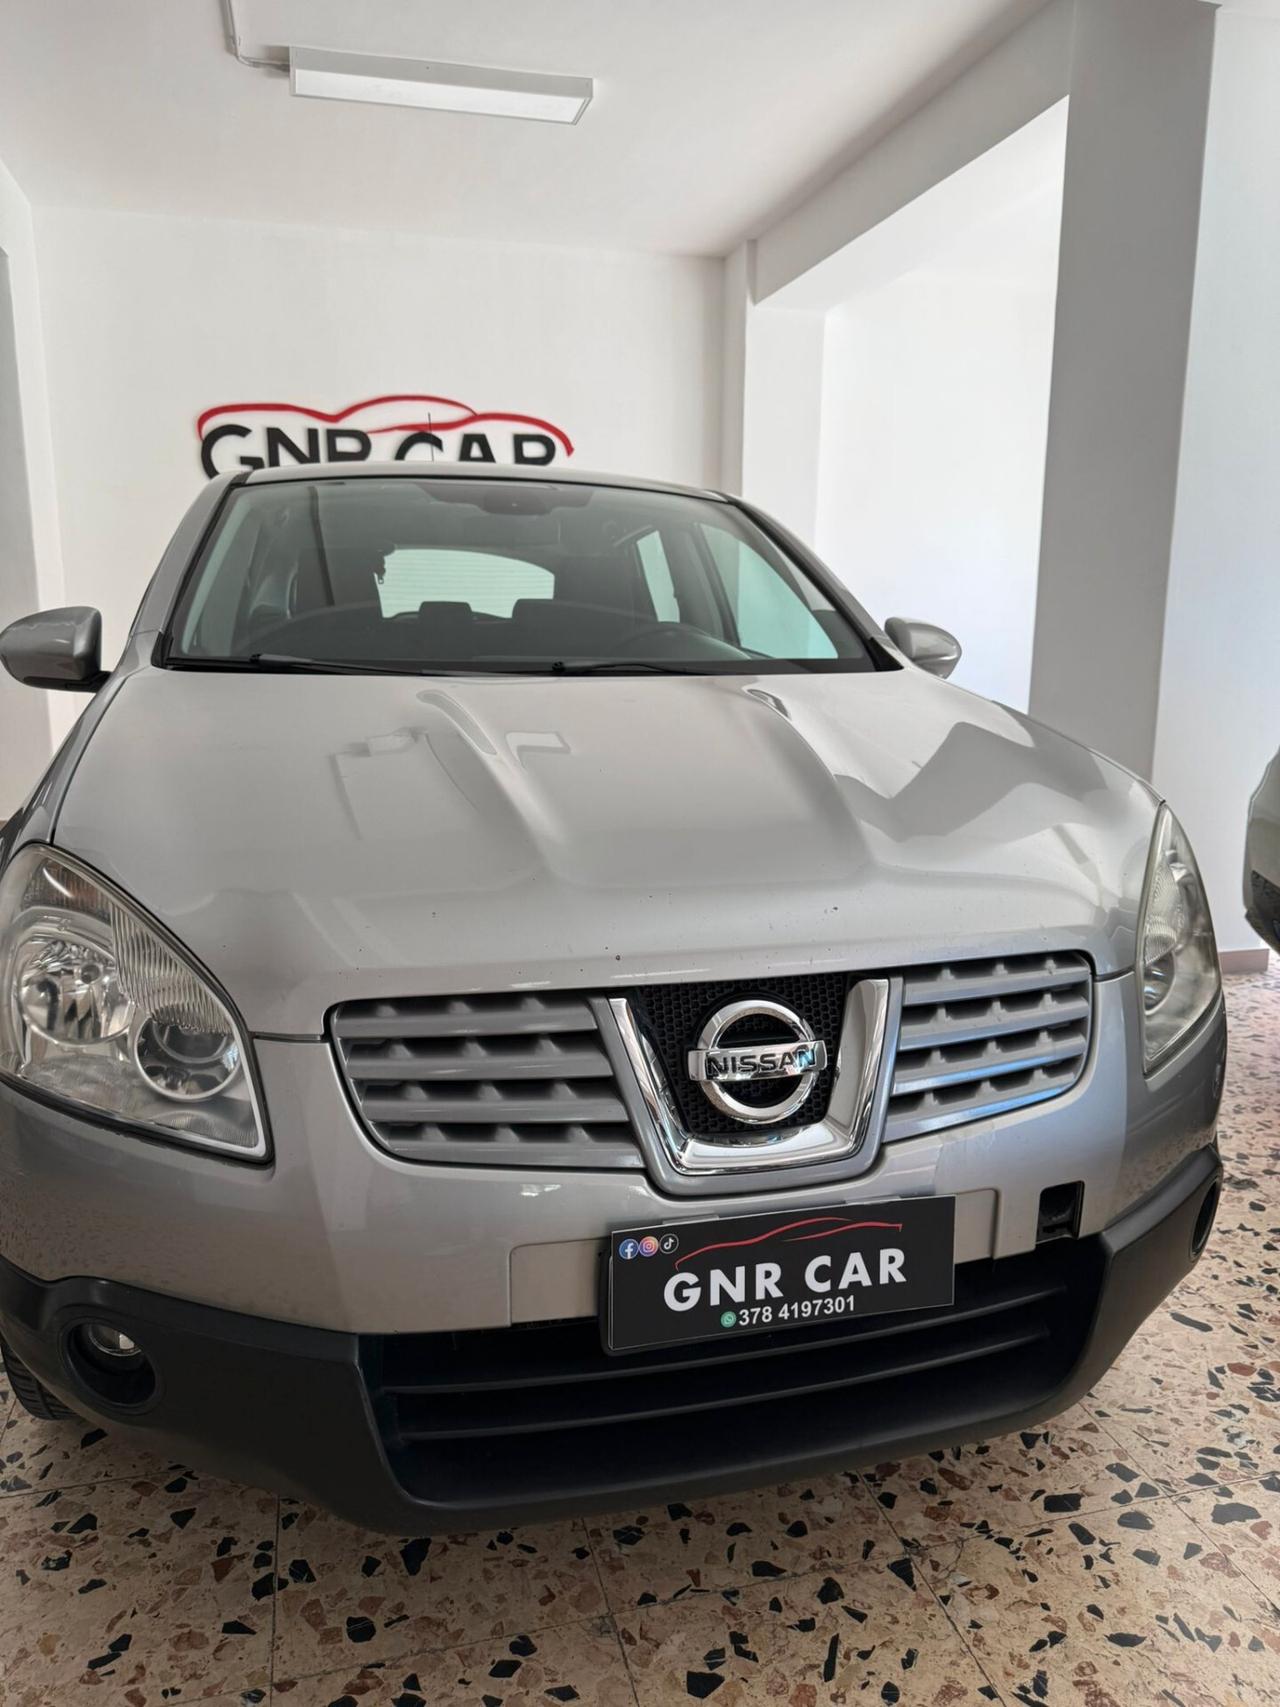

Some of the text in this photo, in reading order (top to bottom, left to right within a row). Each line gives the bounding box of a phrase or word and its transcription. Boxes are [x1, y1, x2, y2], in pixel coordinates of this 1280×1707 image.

[705, 1044, 816, 1079] NISSAN
[664, 1248, 907, 1312] GNR CAR
[738, 1295, 855, 1326] 378 4197301
